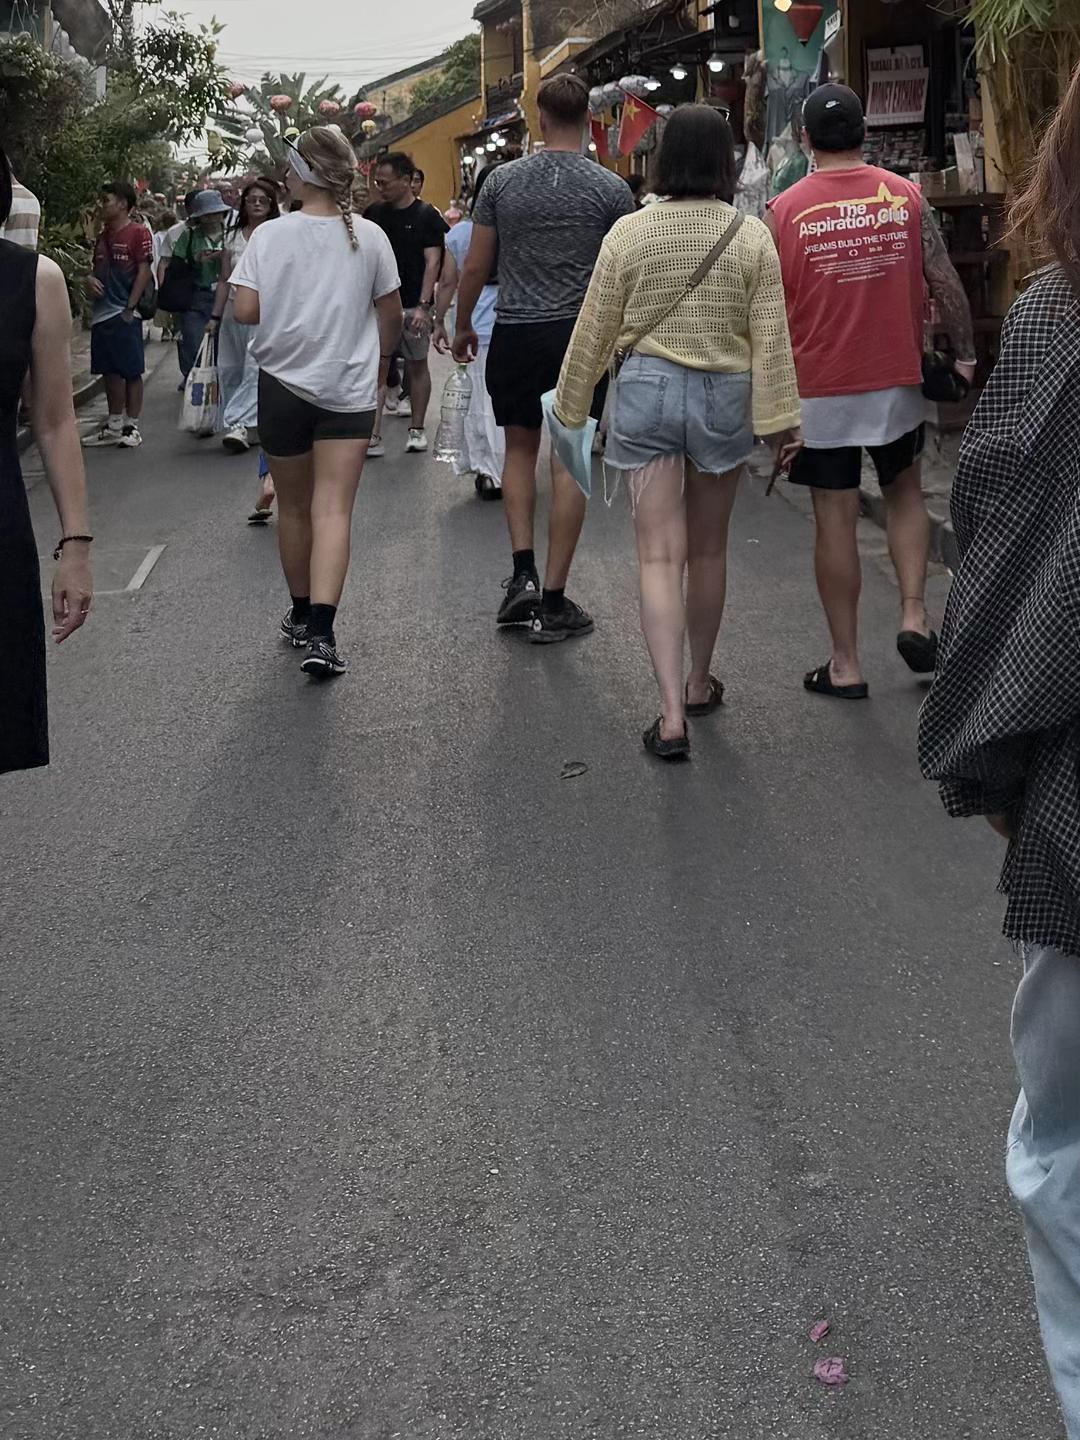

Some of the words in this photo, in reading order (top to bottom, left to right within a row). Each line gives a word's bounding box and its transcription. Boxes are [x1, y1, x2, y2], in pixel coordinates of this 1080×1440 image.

[836, 203, 867, 218] The
[798, 214, 875, 239] Aspiration
[877, 206, 909, 224] Club
[838, 238, 862, 249] BUILD
[862, 234, 879, 245] THE
[879, 231, 910, 242] FUTURE
